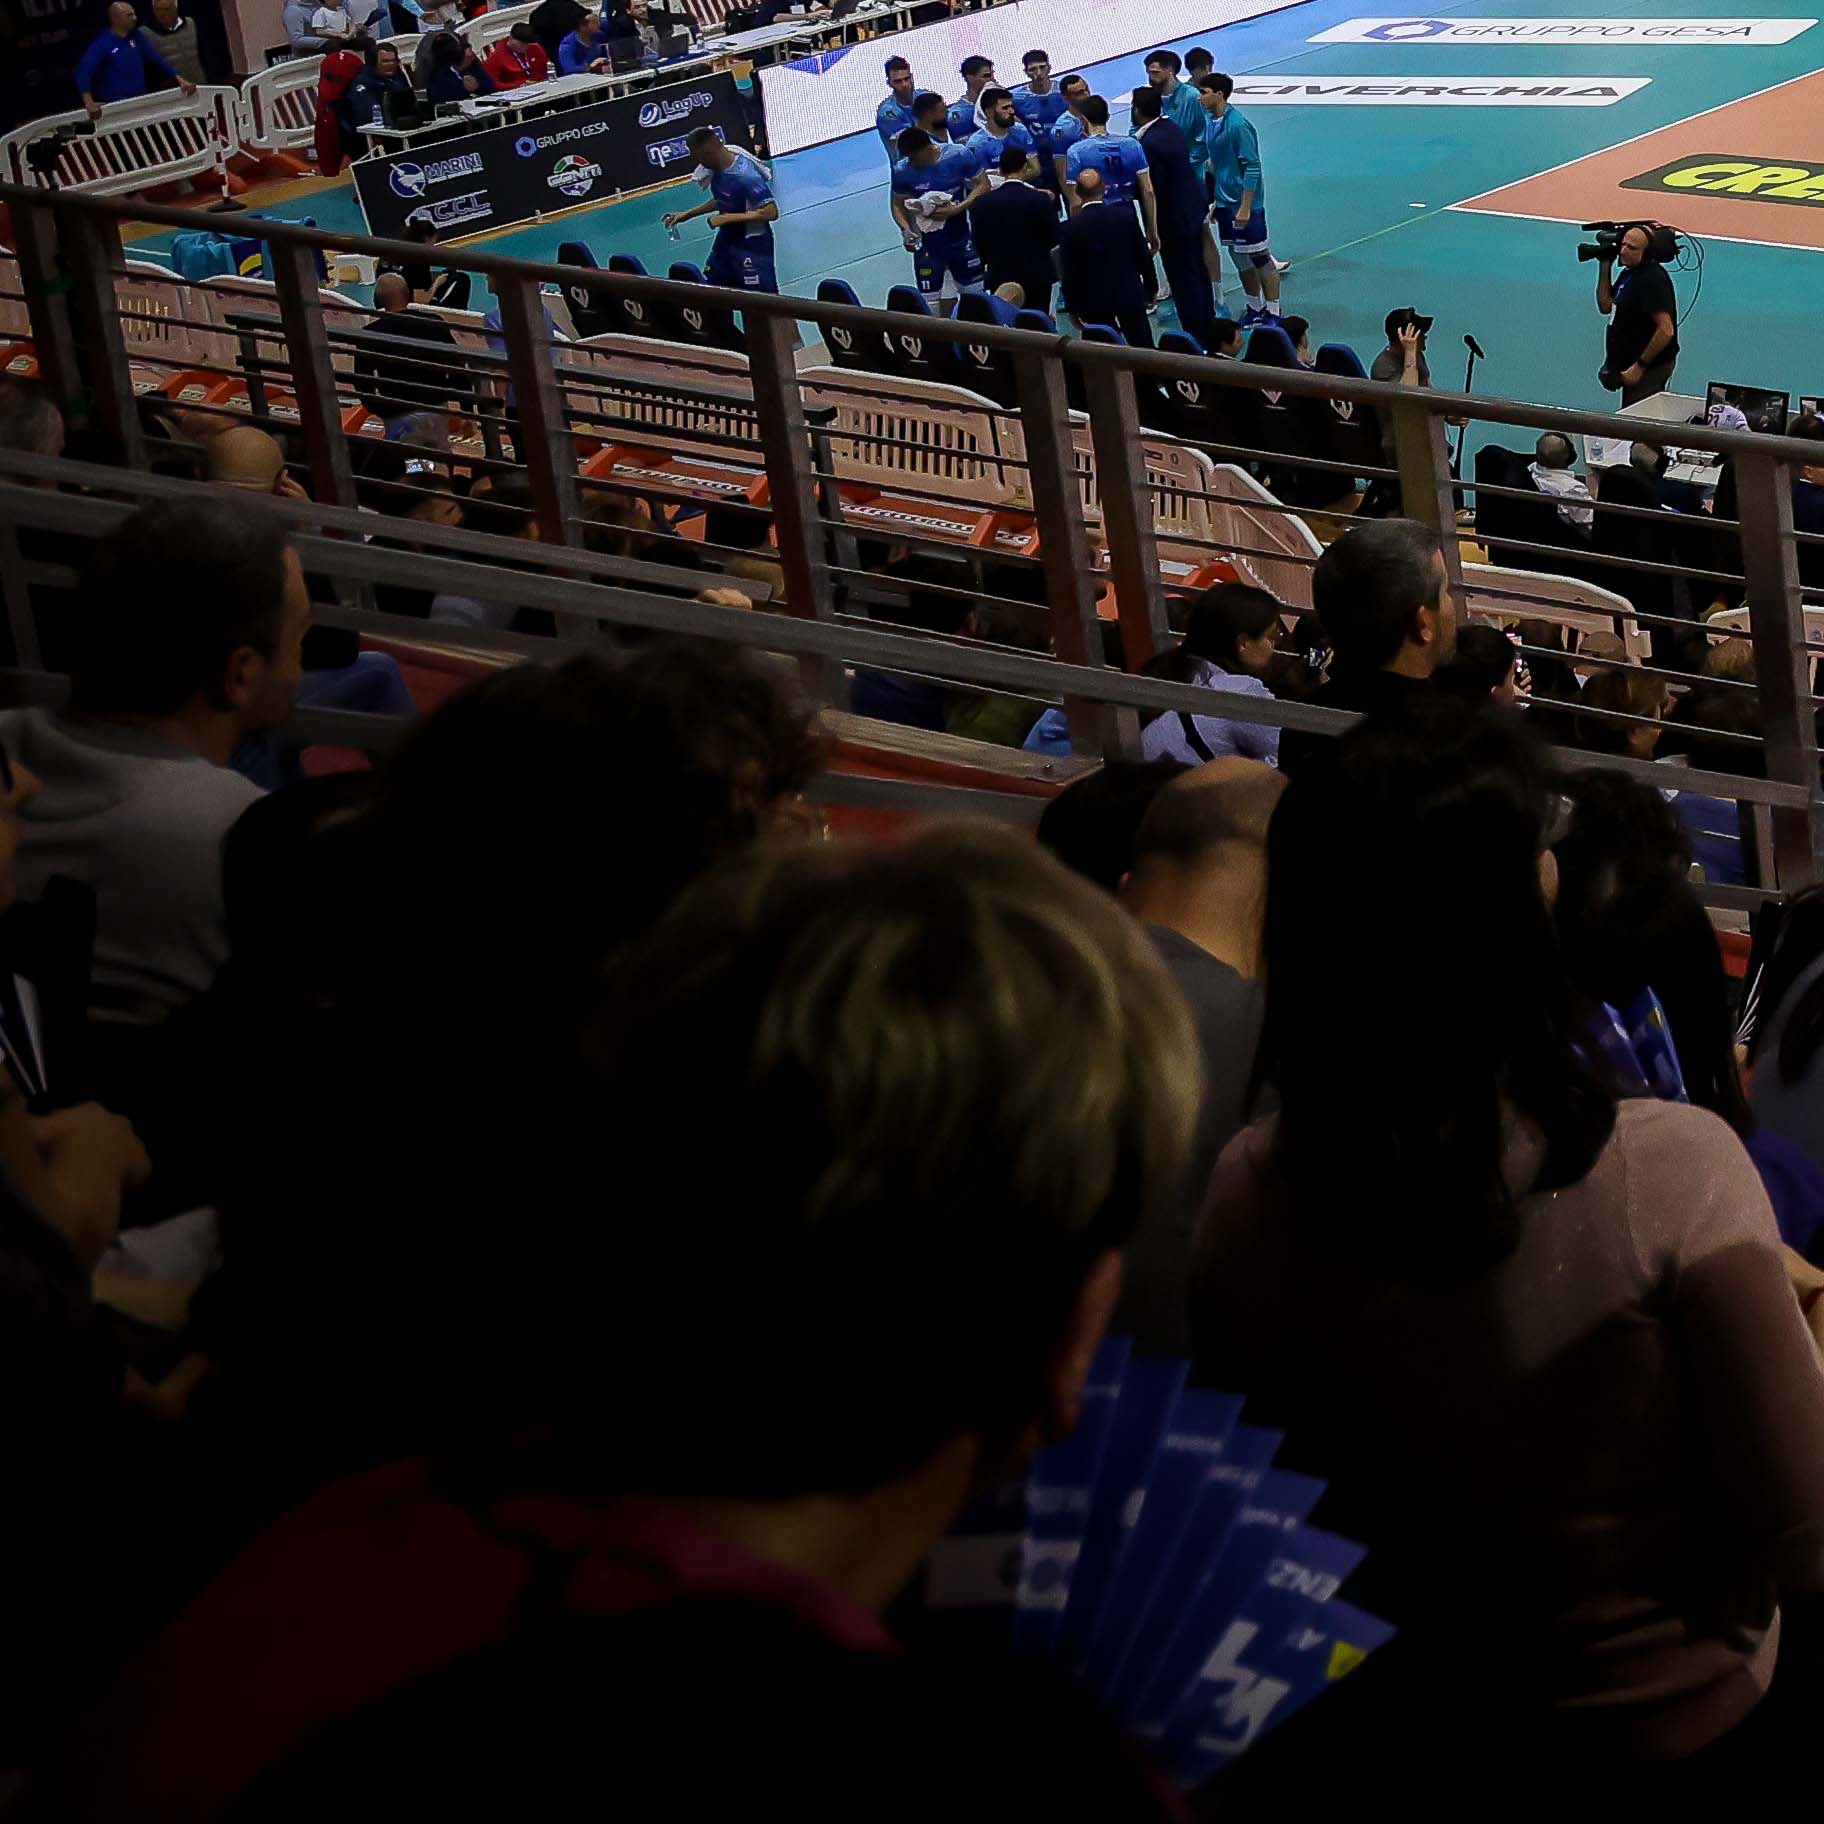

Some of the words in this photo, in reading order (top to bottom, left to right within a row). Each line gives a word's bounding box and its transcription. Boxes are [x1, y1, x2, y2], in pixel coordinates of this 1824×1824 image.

[1451, 24, 1636, 38] GRUPPO
[1642, 24, 1754, 38] GESA
[1231, 84, 1620, 98] CIVERCHIA
[537, 127, 581, 150] GRUPPO
[581, 121, 609, 142] GESA
[424, 153, 482, 180] MARINI
